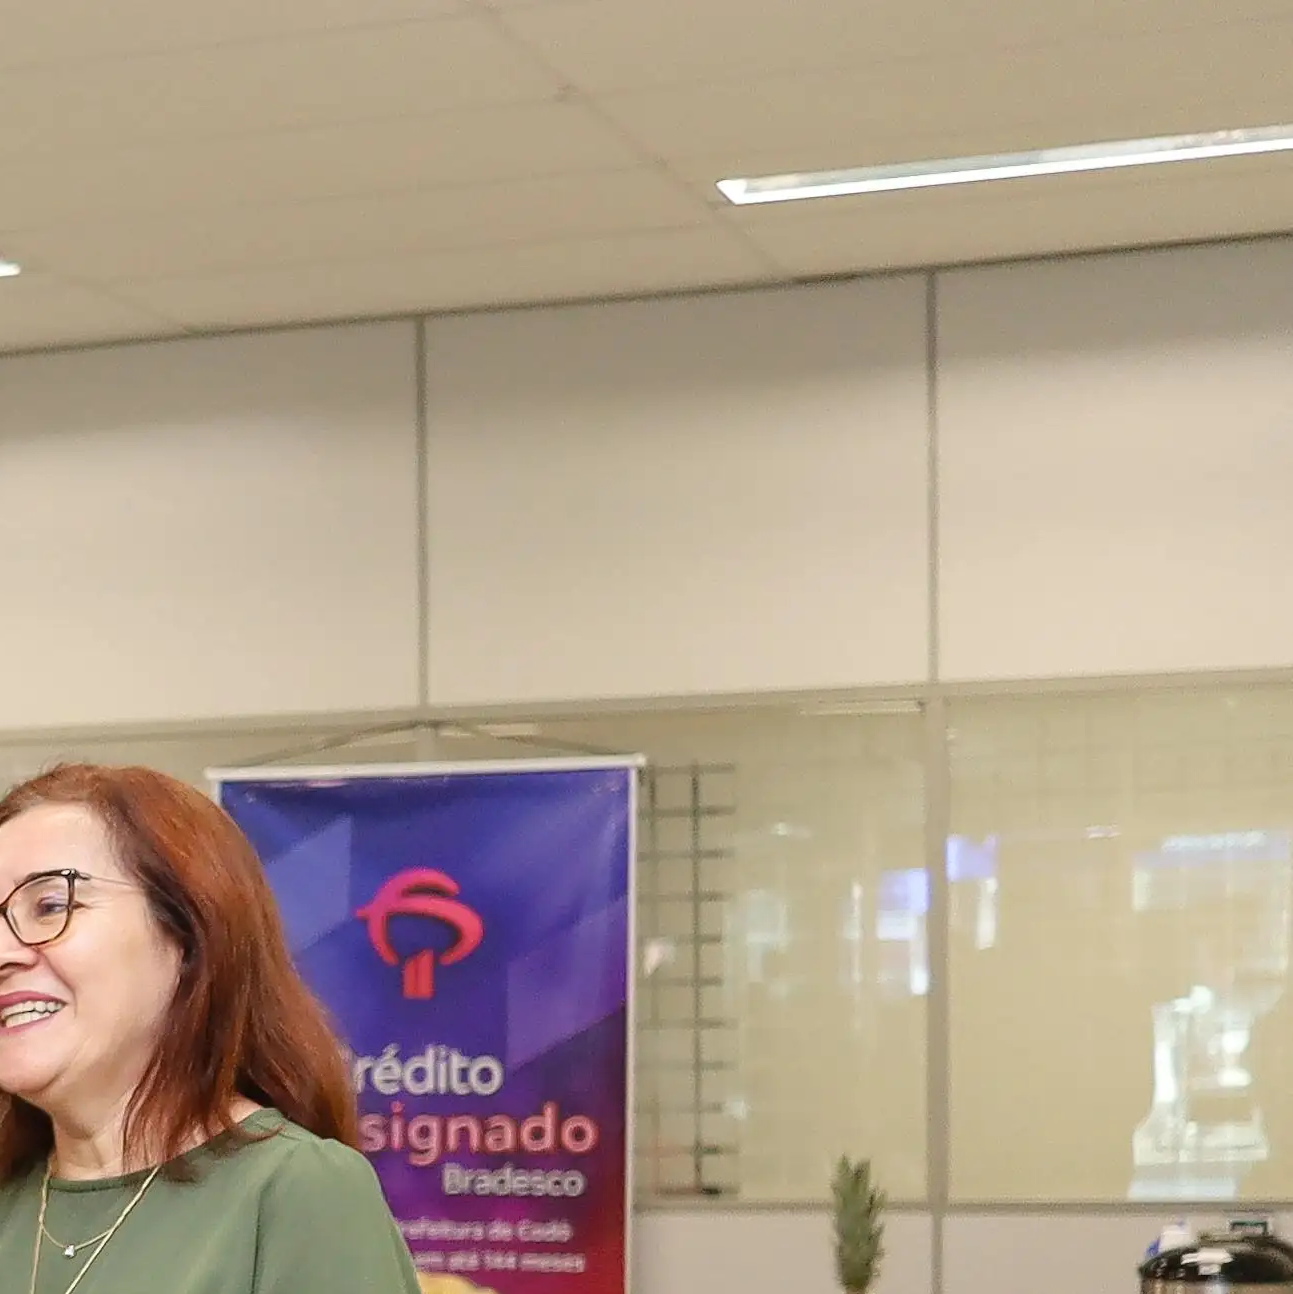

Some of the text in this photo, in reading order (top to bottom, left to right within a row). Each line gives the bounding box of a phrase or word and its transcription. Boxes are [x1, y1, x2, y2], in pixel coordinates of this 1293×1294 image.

[351, 1043, 505, 1096] rédito
[357, 1100, 600, 1167] signado
[441, 1161, 587, 1197] Bradesco
